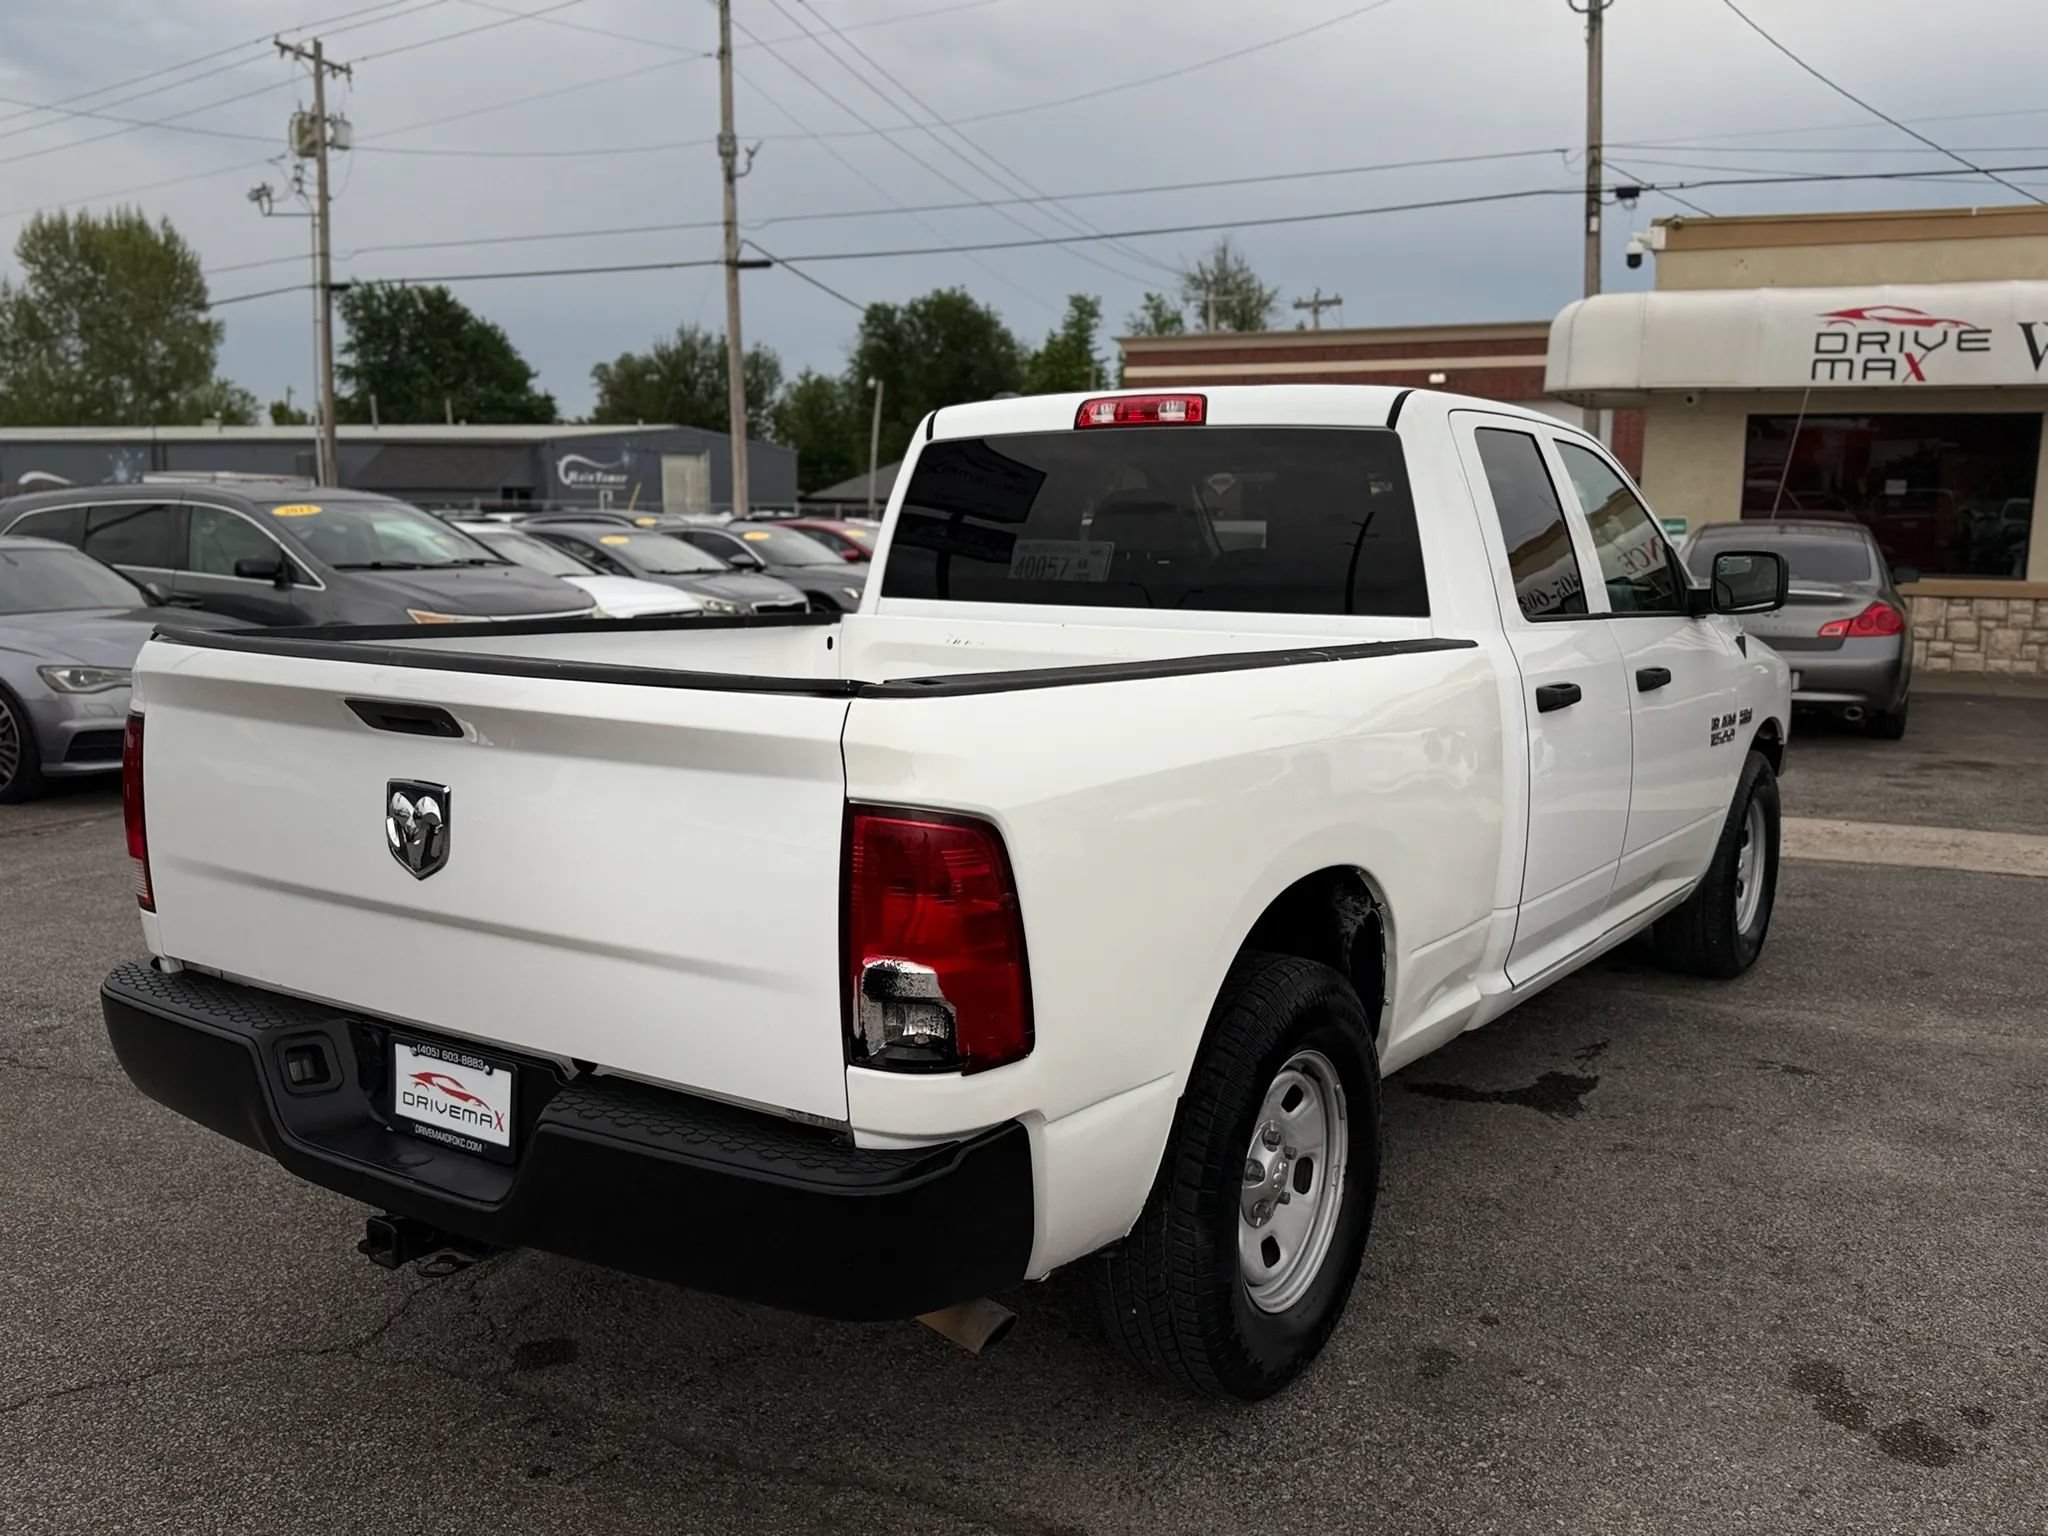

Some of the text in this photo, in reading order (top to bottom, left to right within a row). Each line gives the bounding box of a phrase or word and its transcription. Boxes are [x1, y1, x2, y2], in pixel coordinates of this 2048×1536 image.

[1815, 329, 1992, 353] DRIVE
[1811, 352, 1926, 383] MAX
[1711, 712, 1736, 731] RAM
[416, 1043, 484, 1070] (405) 603-8883
[403, 1091, 505, 1133] DRIVEMAX
[414, 1124, 483, 1153] DRIVEMAXOFOKC.COM
